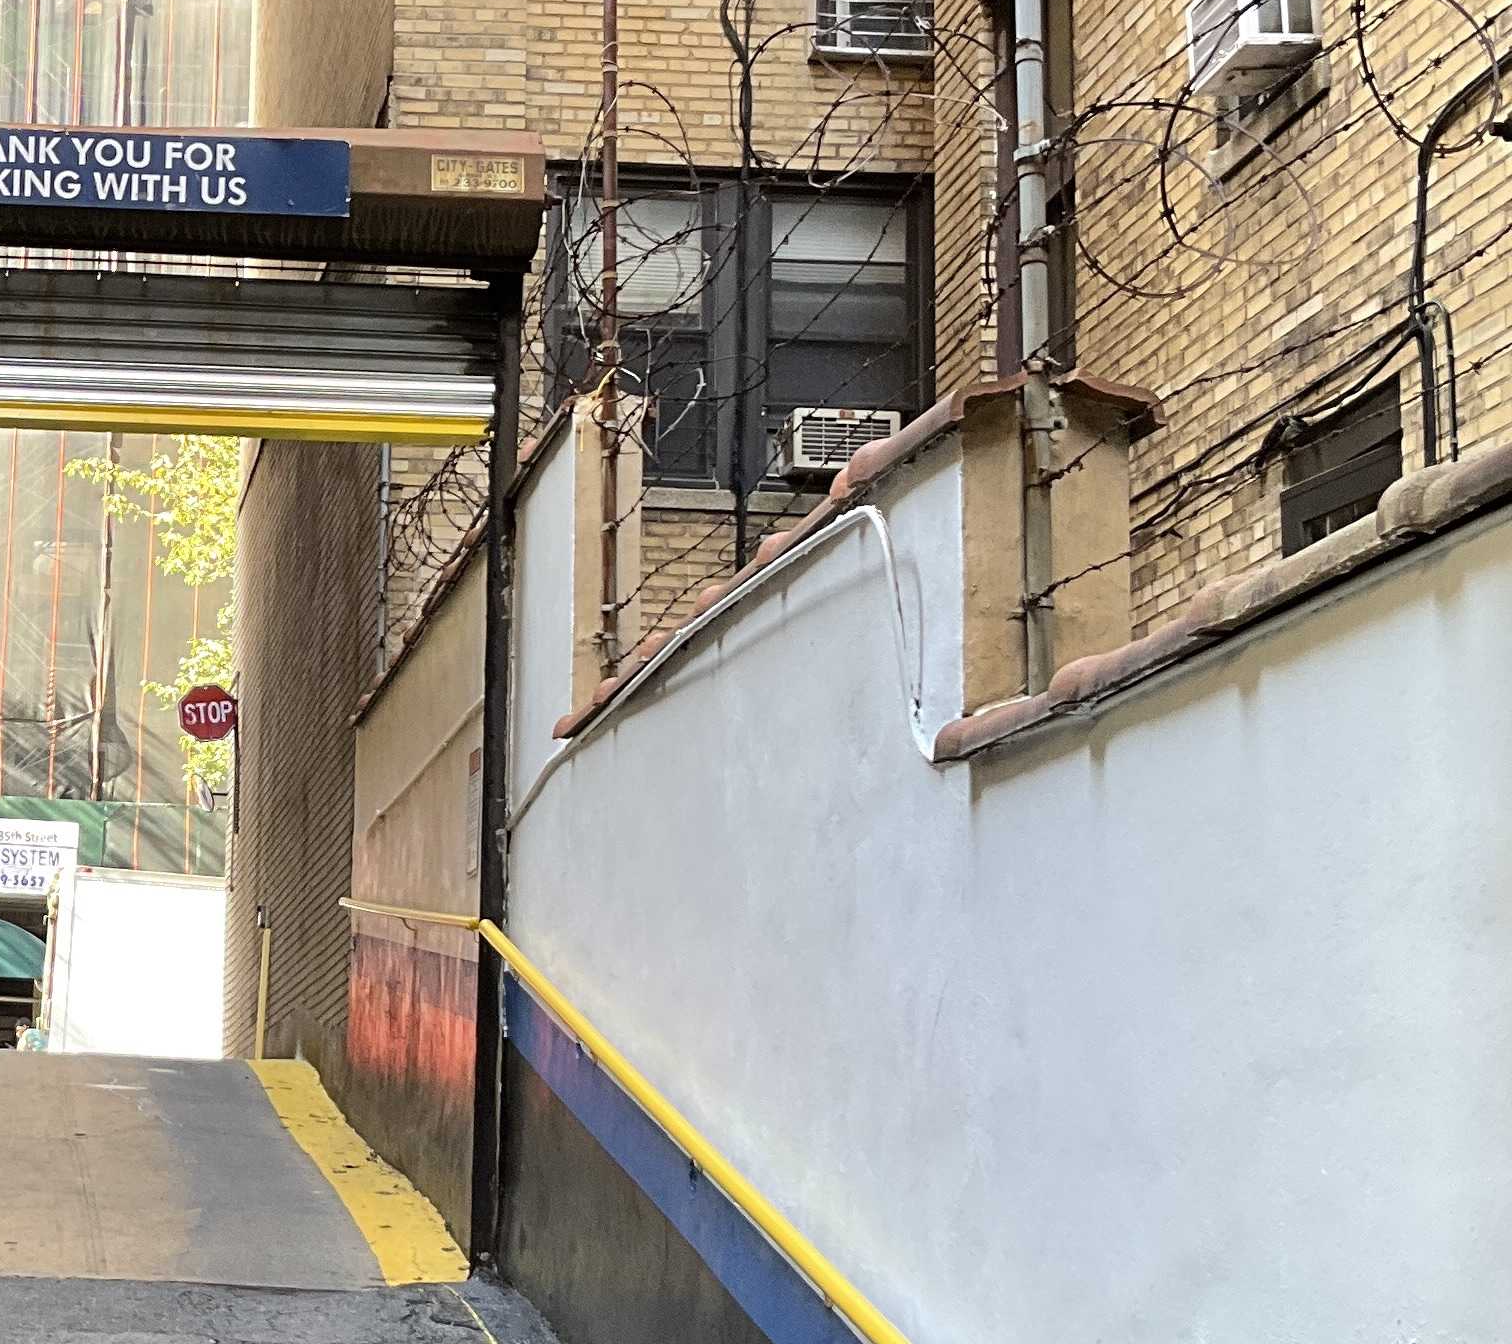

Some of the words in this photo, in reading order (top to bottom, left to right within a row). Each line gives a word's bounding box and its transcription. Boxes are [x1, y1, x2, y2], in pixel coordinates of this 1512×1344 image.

[72, 137, 151, 168] YOU
[165, 142, 236, 172] FOR
[93, 172, 186, 203] WITH
[200, 176, 248, 206] US
[184, 700, 233, 725] STOP
